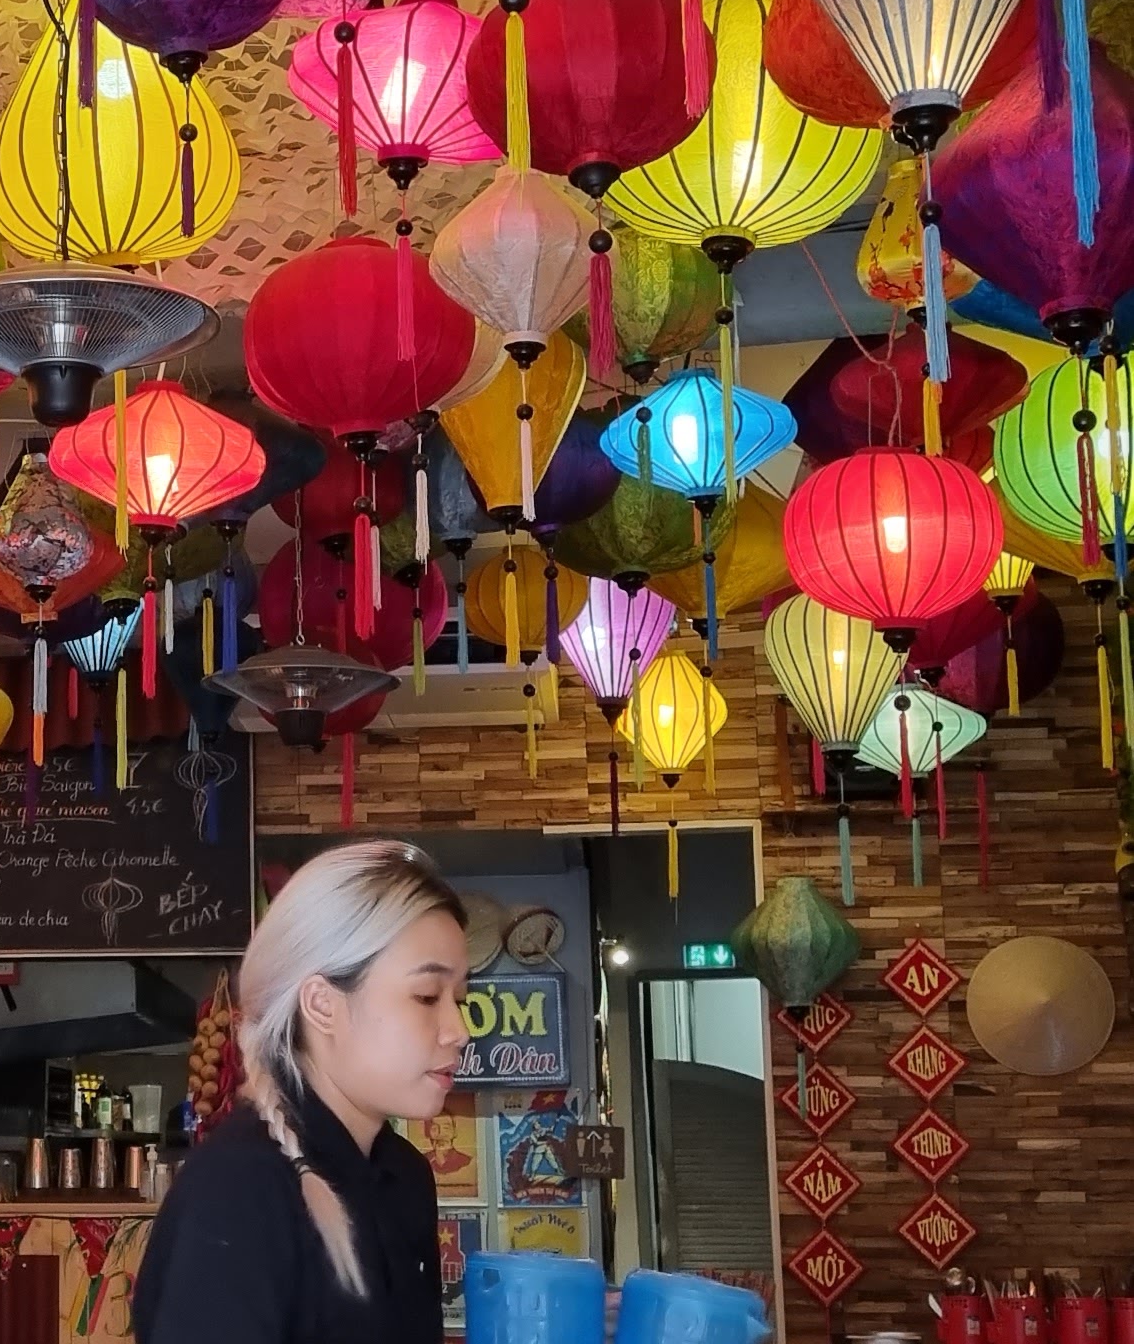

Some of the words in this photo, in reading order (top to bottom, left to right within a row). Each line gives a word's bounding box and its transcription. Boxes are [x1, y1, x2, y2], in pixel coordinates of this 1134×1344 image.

[40, 773, 97, 802] Saigon
[18, 909, 36, 927] de
[902, 961, 940, 997] AN
[803, 999, 837, 1035] HÚC
[489, 1041, 559, 1075] Dân
[906, 1043, 947, 1082] KHANG
[802, 1158, 843, 1204] NĂM
[806, 1246, 846, 1288] MỚI
